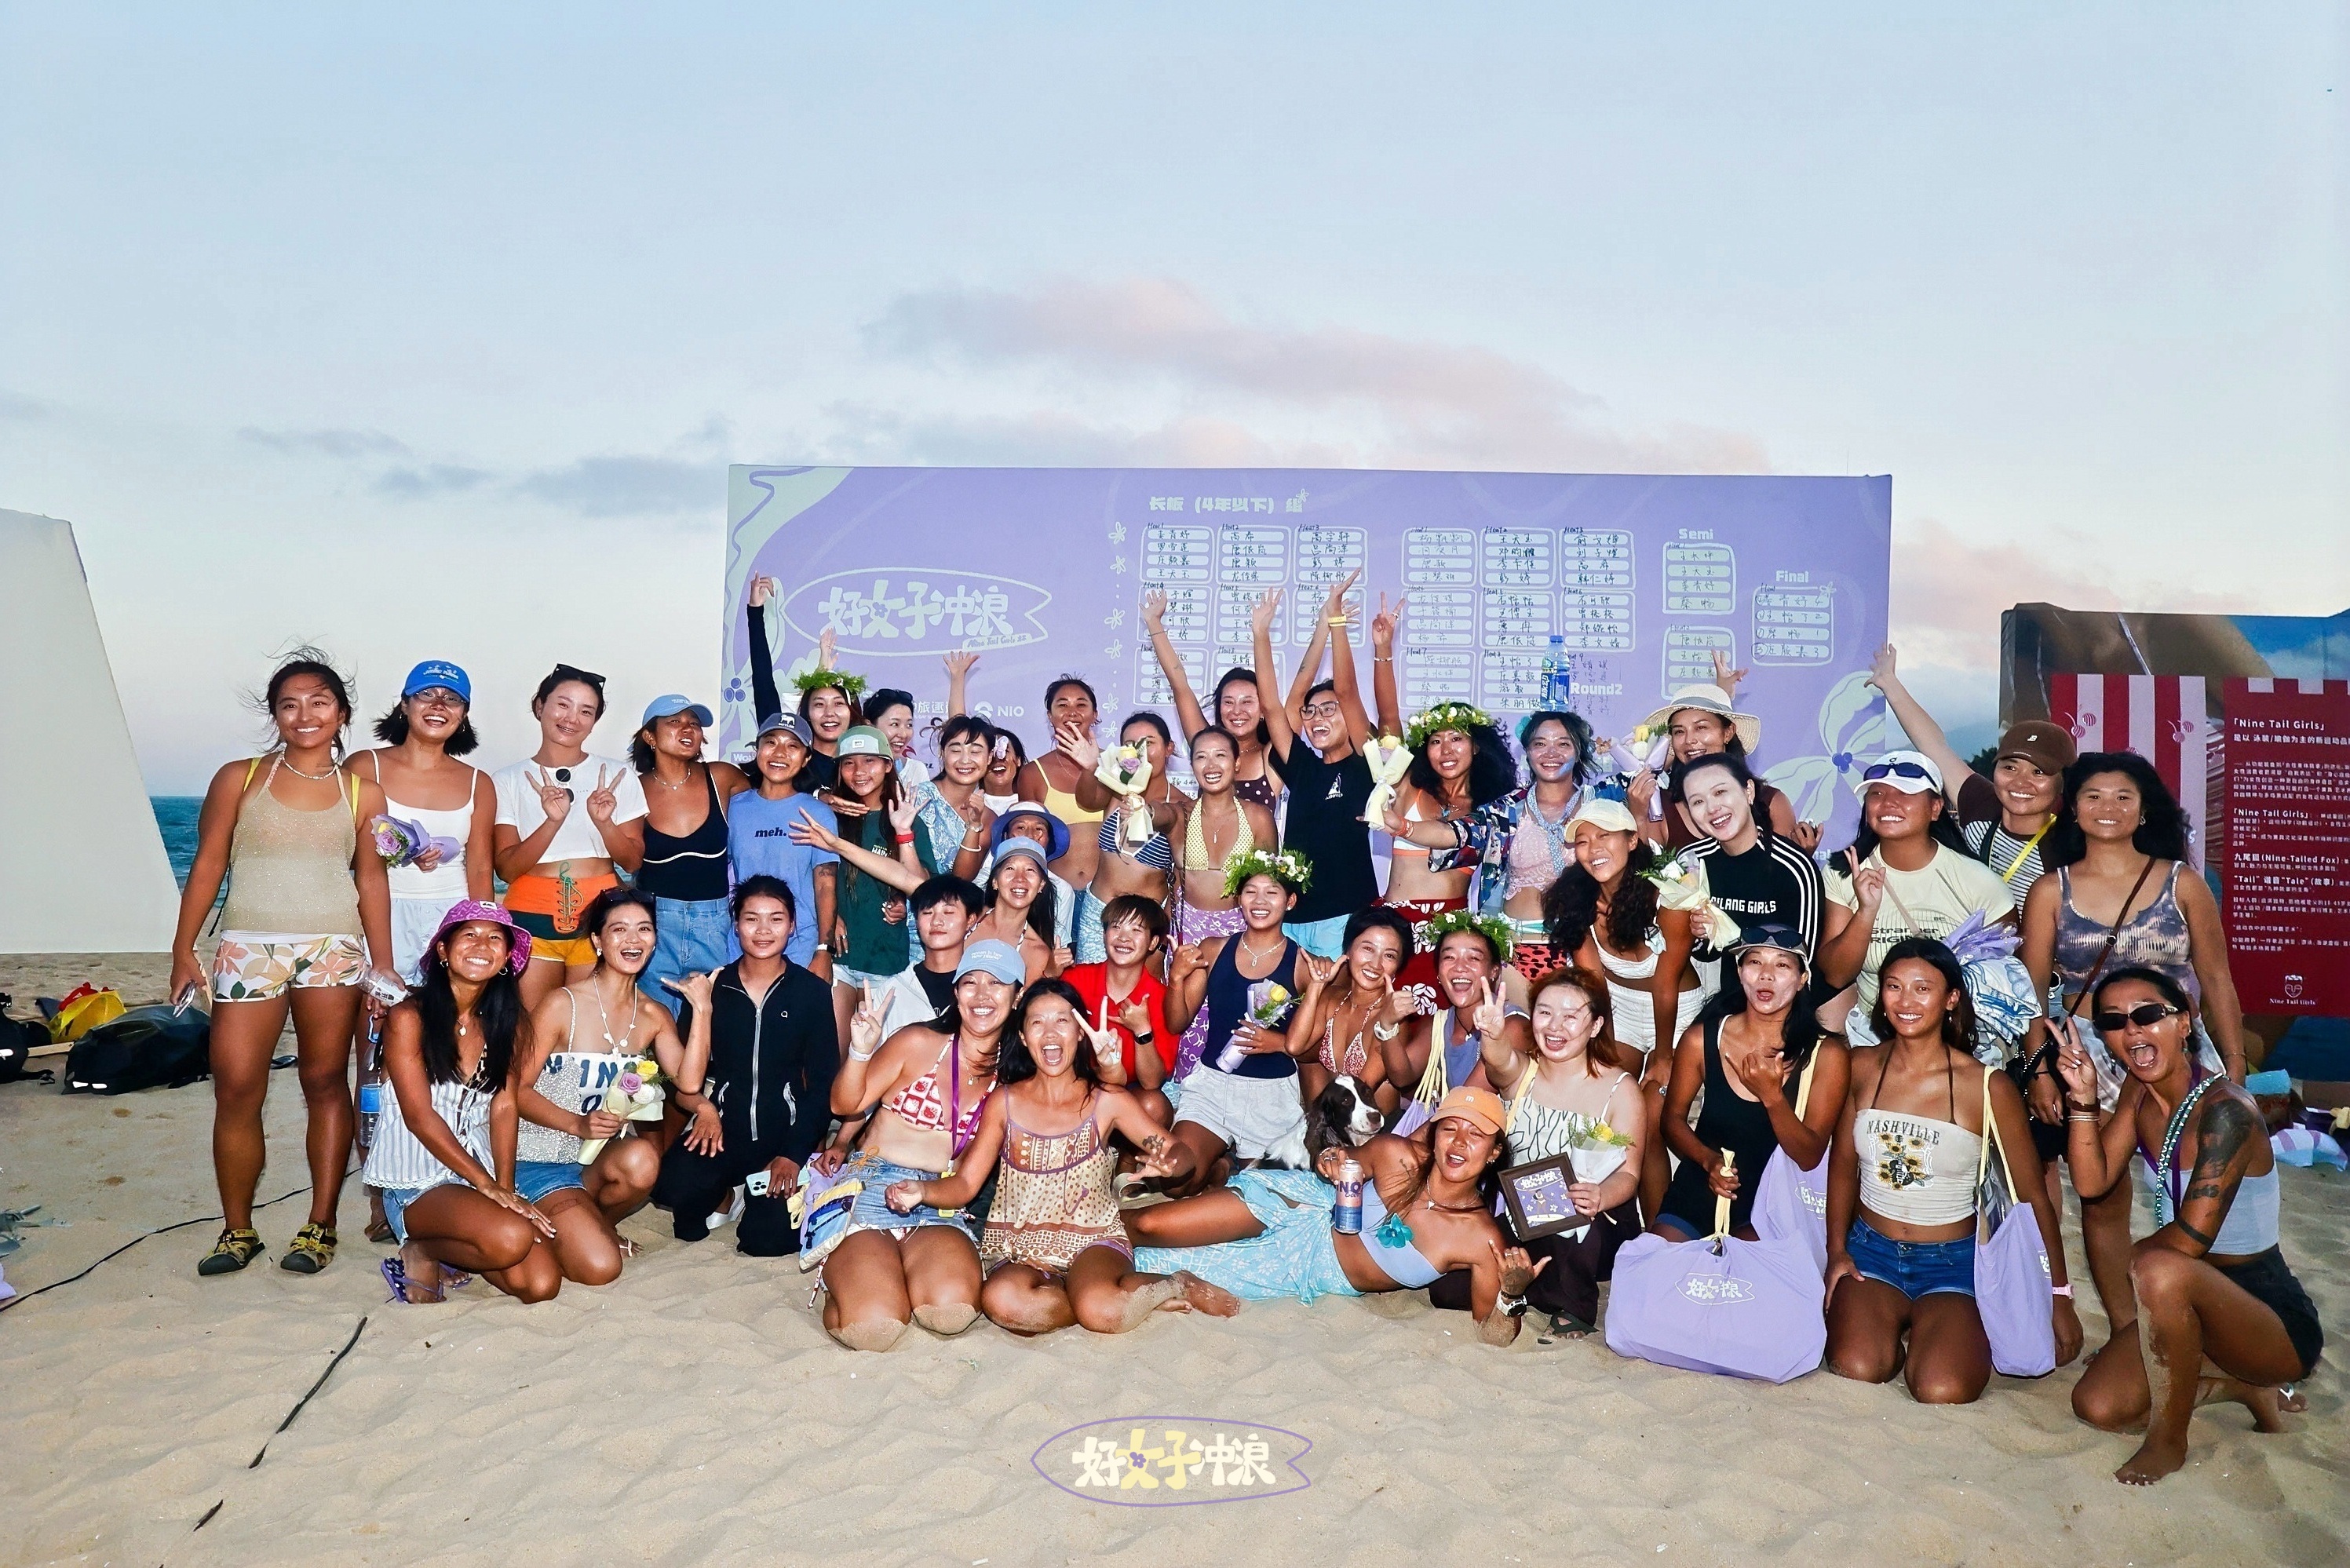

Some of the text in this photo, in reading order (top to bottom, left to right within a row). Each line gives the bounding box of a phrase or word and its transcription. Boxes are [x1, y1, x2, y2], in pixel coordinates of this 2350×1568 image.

[1679, 528, 1713, 540] Semi
[1775, 571, 1809, 582] Final
[818, 579, 1014, 639] 好女子冲浪
[1570, 682, 1622, 695] Round2
[997, 706, 1024, 717] NIO
[2269, 720, 2290, 729] Tail
[2263, 809, 2279, 818] Tail
[754, 827, 787, 838] meh.
[1747, 900, 1776, 914] GIRLS
[1866, 1120, 1940, 1146] NASHVILLE
